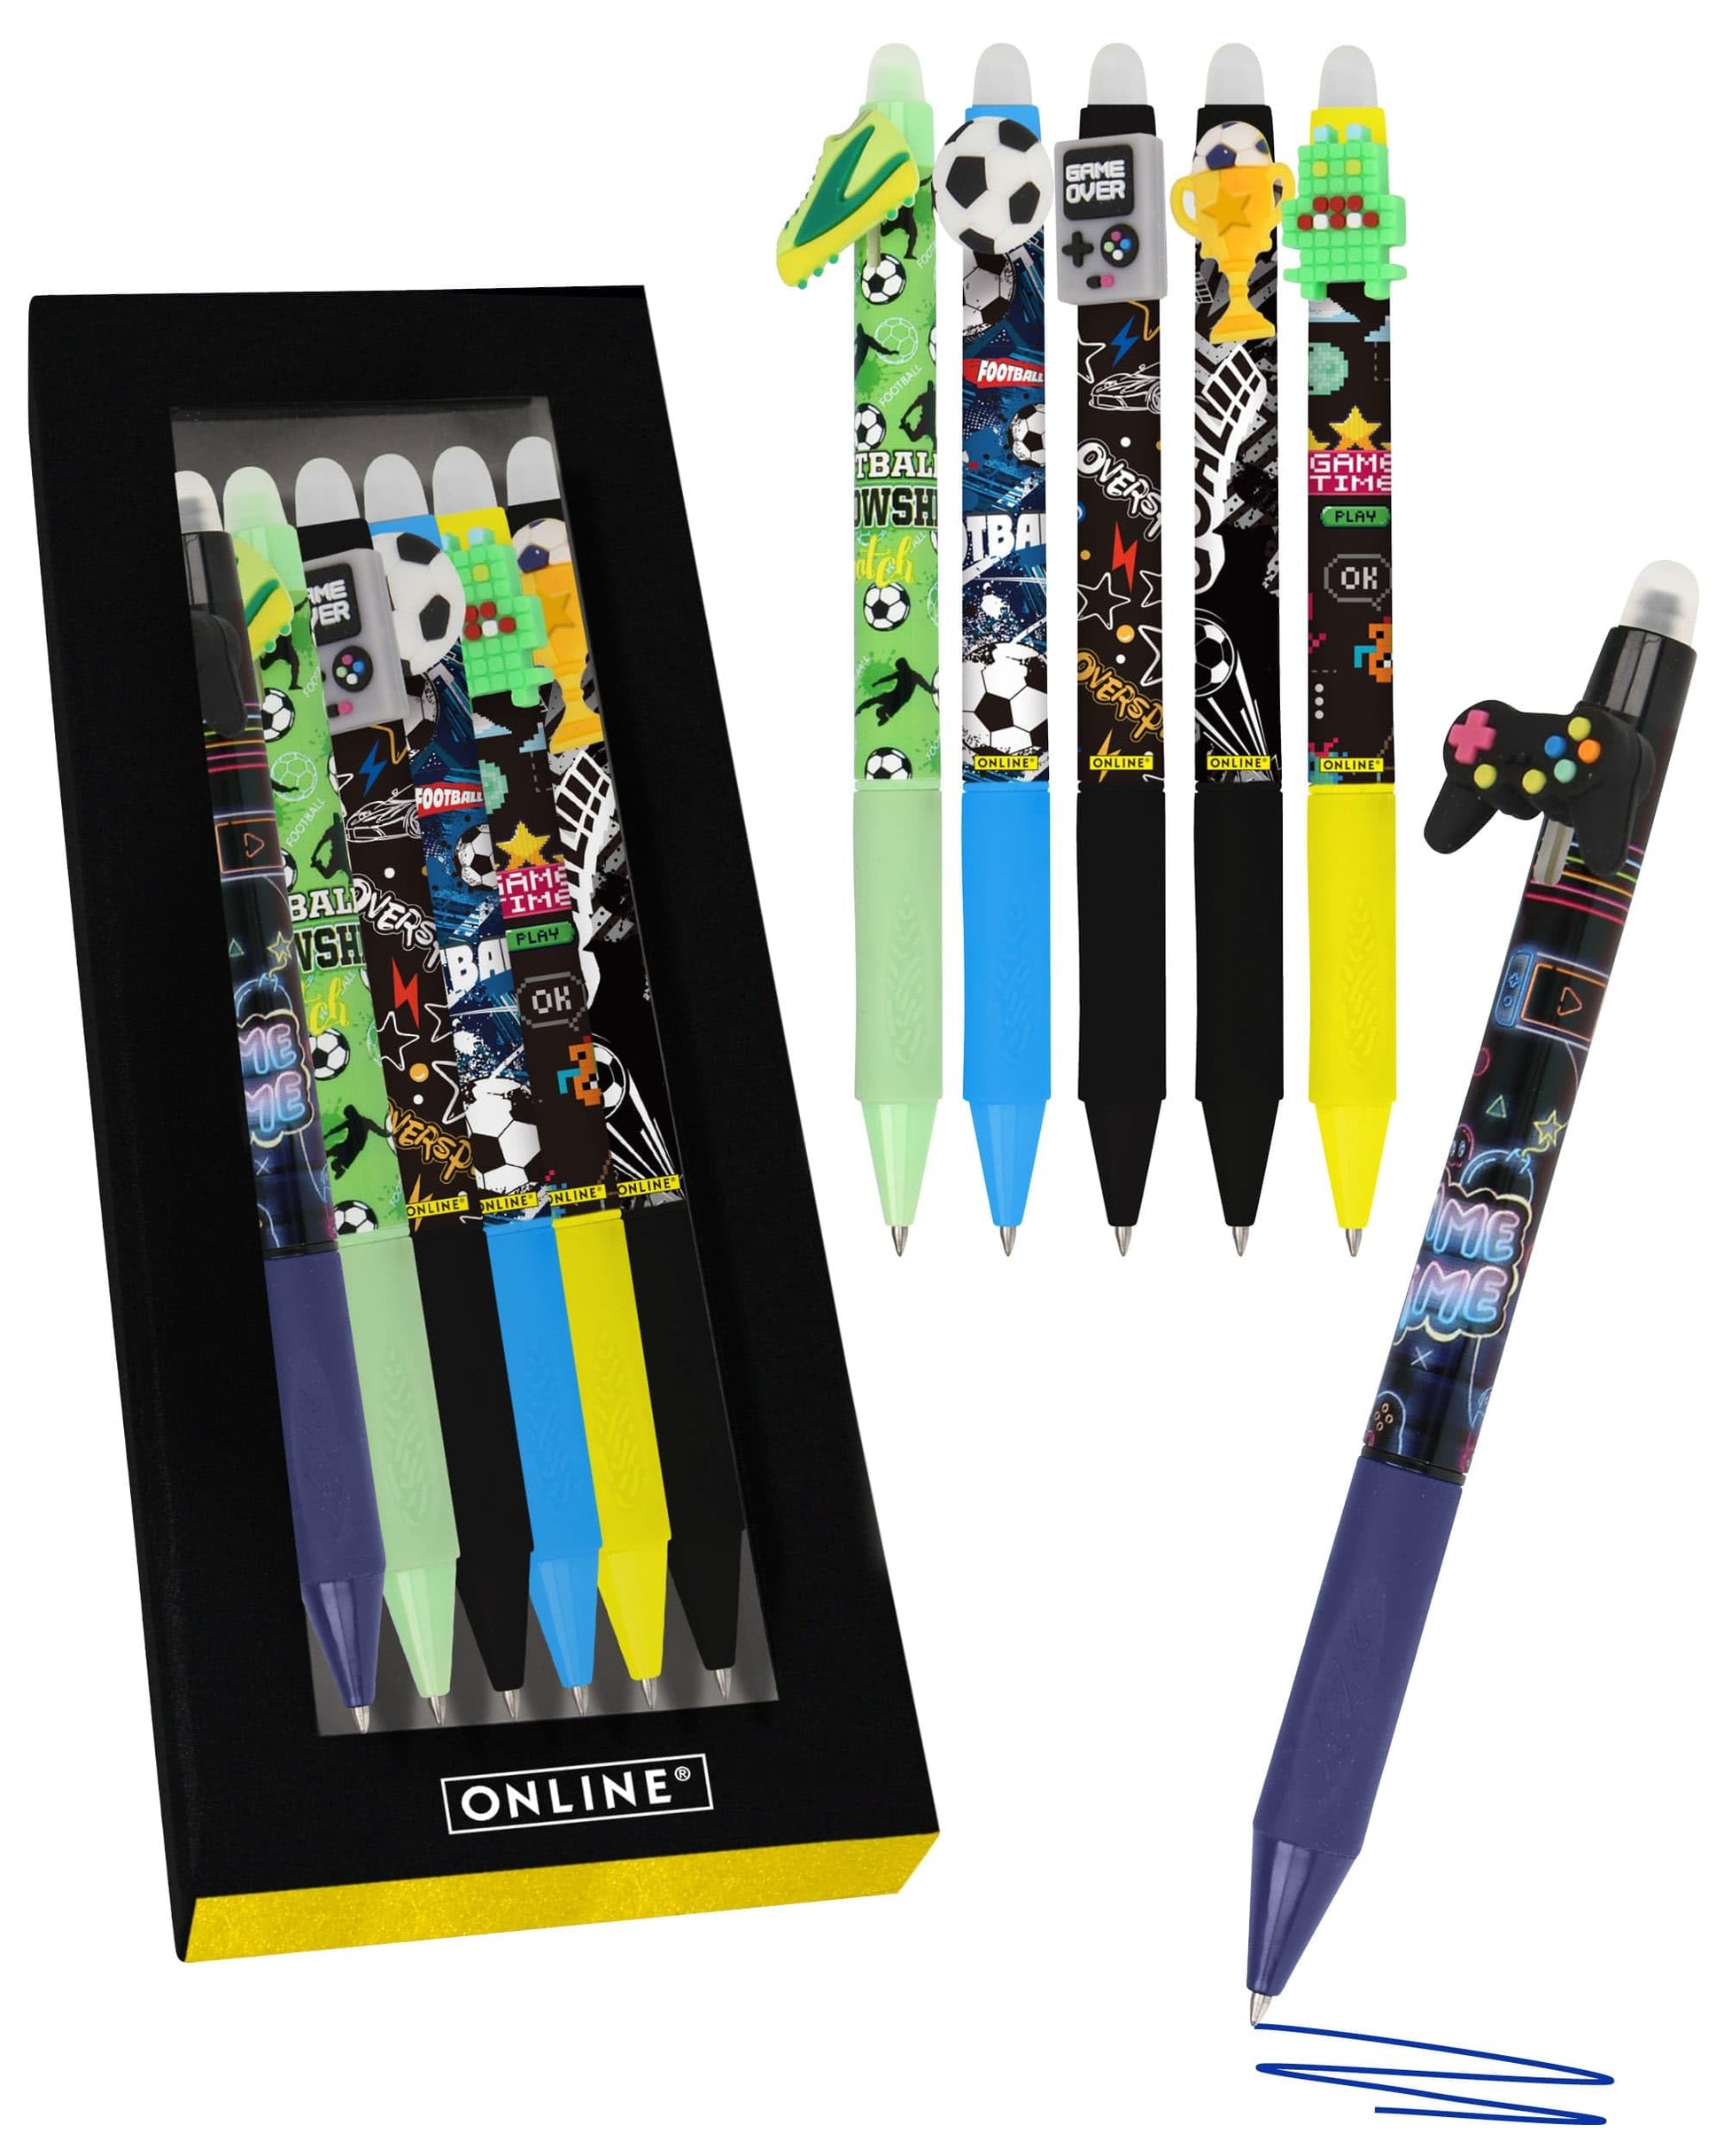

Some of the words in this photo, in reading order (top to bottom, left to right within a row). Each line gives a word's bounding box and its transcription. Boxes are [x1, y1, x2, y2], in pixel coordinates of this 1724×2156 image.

[1066, 160, 1125, 183] GAME
[1066, 179, 1126, 204] OVER
[977, 360, 1044, 383] FOOTBALL
[879, 364, 921, 408] FOOTBALL
[1309, 475, 1392, 492] TIME
[1335, 510, 1376, 523] PLAY
[1341, 566, 1378, 590] OK
[285, 798, 326, 846] FOOTBALL
[516, 928, 560, 946] PLAY
[532, 985, 572, 1015] OK
